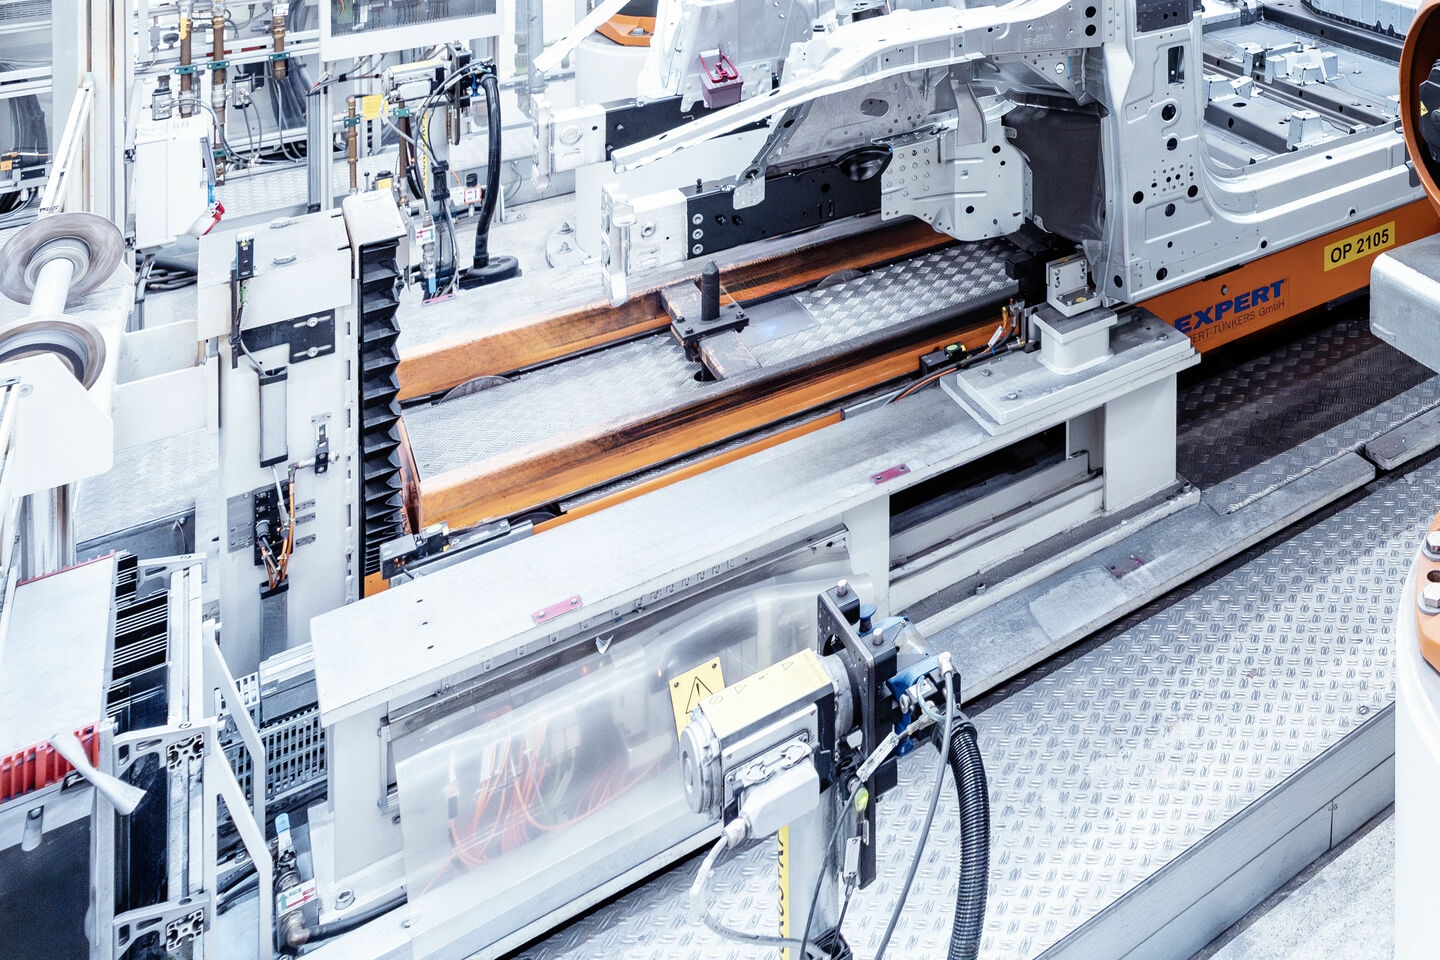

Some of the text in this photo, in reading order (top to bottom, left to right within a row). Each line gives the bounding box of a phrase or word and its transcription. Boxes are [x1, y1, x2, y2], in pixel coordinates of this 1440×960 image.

[1330, 228, 1389, 263] OP 2105
[1174, 279, 1285, 334] EXPERT
[1258, 299, 1285, 317] GmbH
